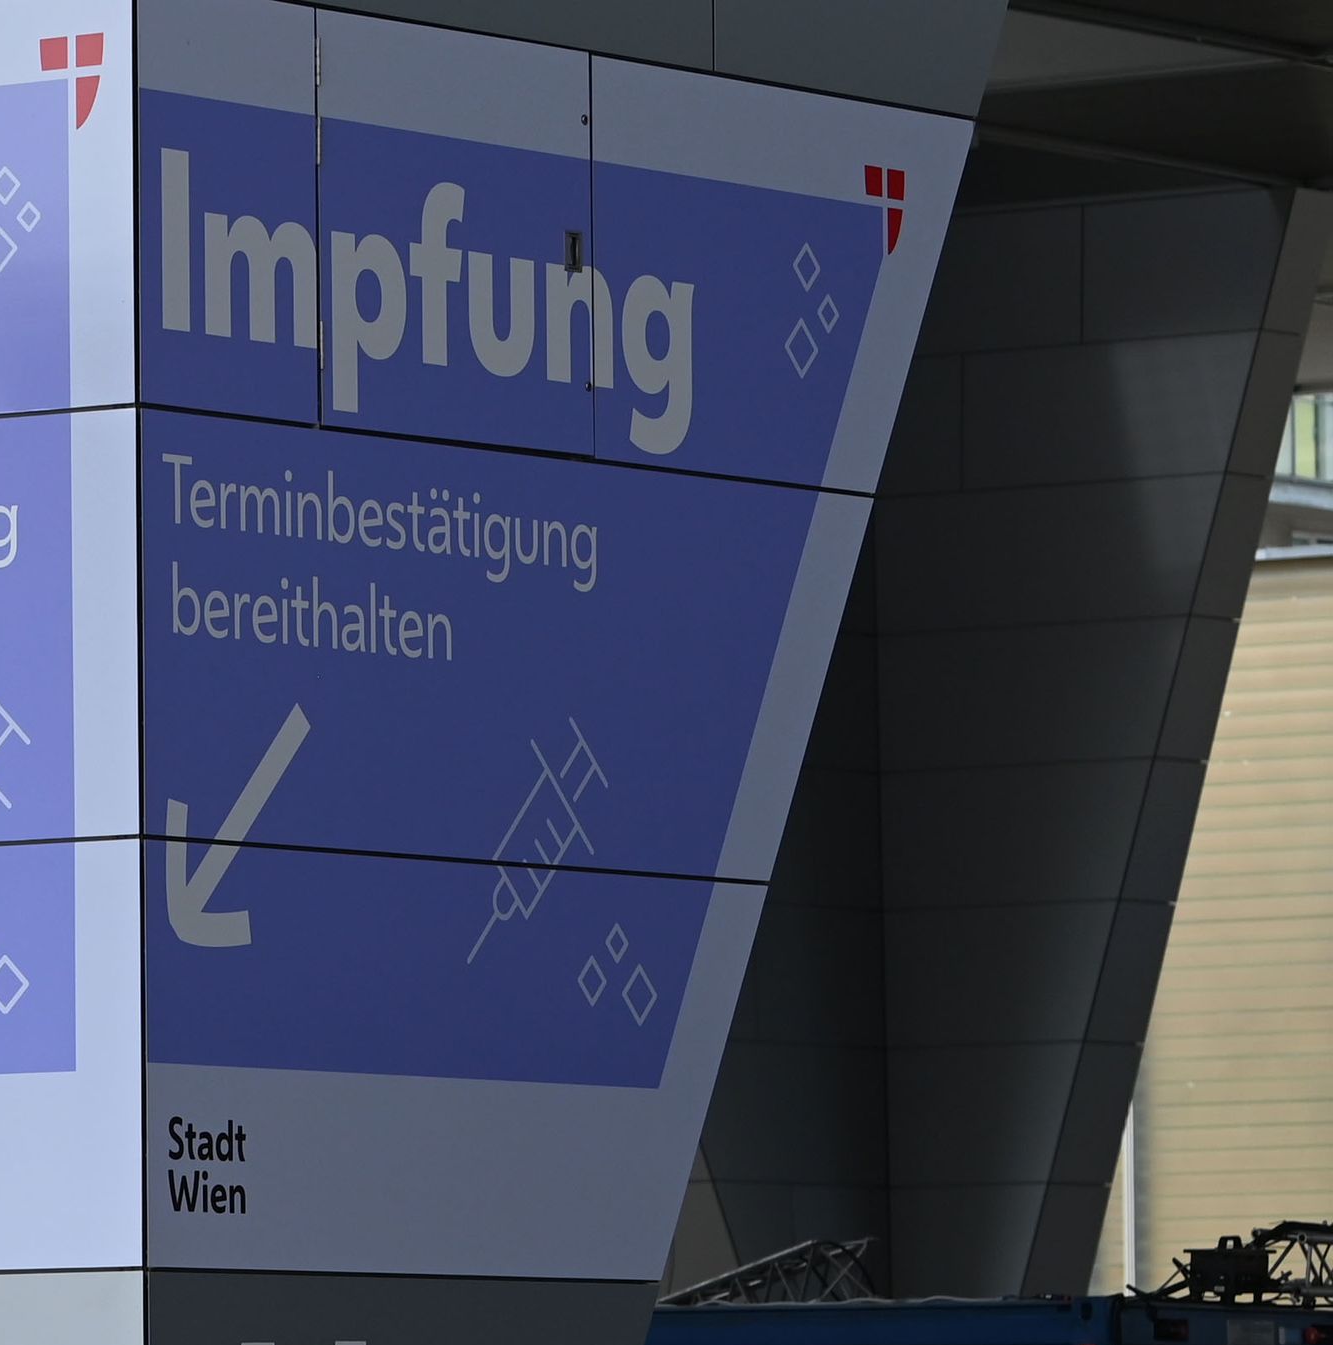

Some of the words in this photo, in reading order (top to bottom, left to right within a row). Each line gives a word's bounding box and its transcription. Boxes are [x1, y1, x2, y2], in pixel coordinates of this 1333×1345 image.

[160, 148, 695, 455] Impfung
[162, 453, 599, 592] Terminbestätigung
[171, 562, 453, 661] bereithalten
[168, 1116, 247, 1162] Stadt
[168, 1169, 247, 1214] Wien
